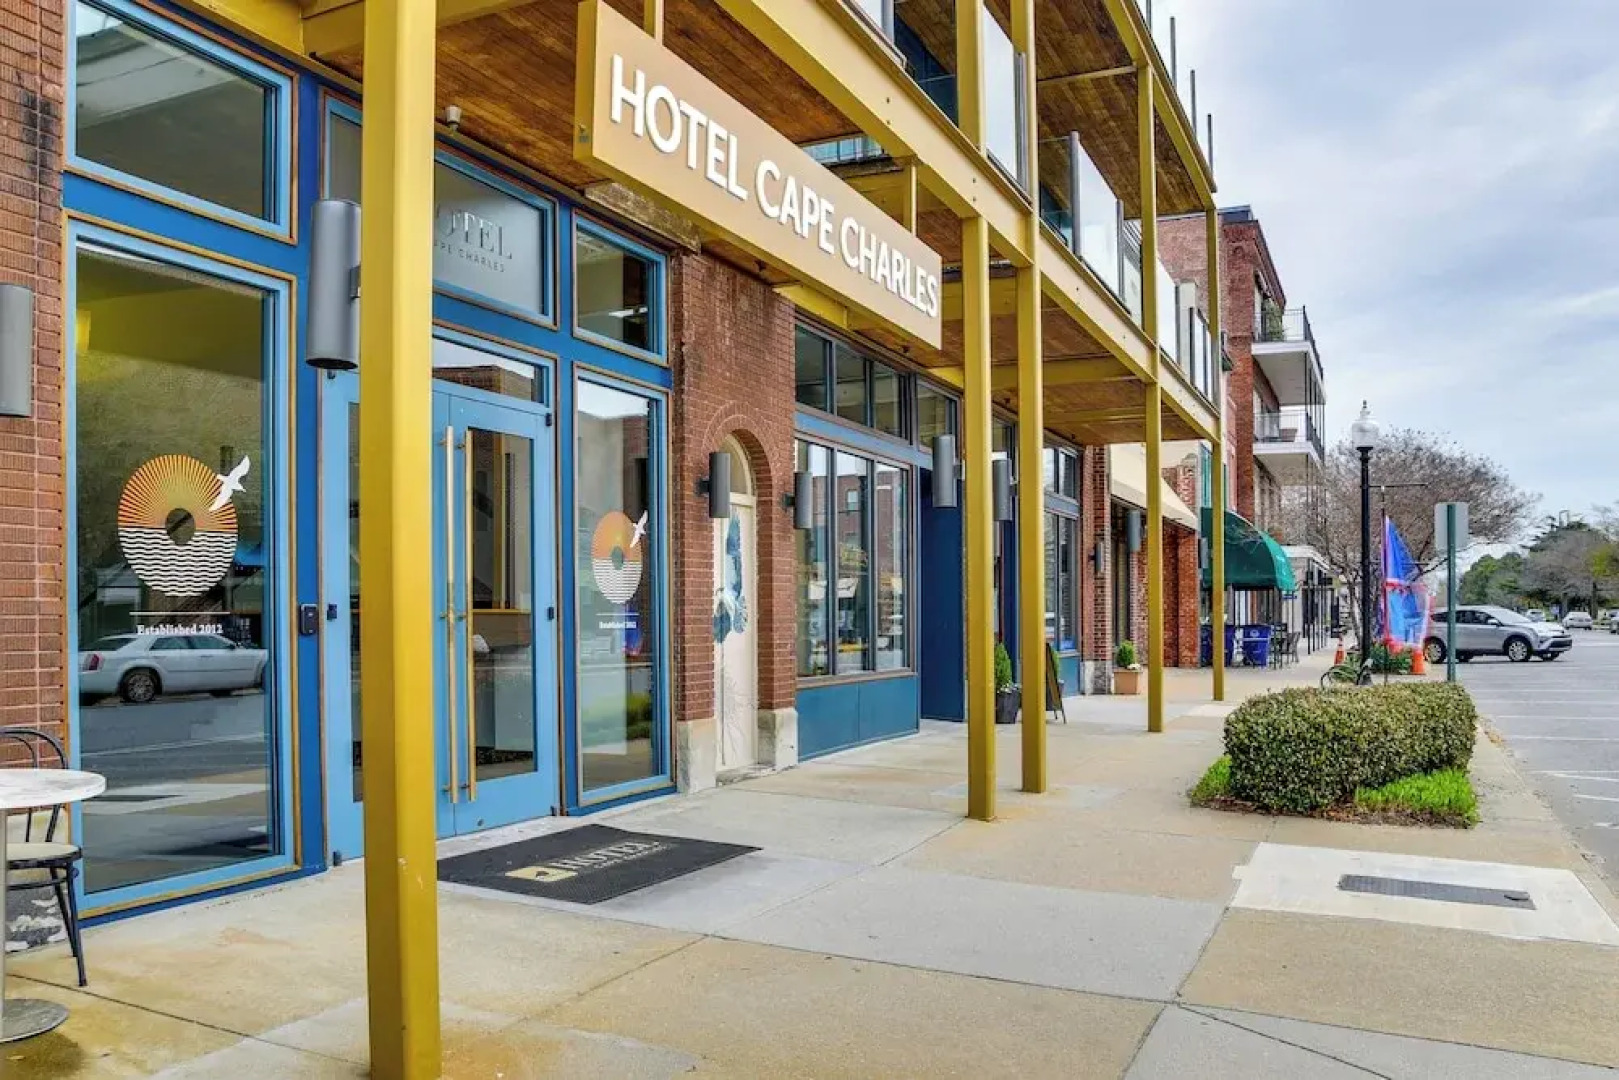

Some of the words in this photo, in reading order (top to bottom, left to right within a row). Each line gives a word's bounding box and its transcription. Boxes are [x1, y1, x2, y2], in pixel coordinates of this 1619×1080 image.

[610, 53, 748, 201] HOTEL
[755, 159, 835, 254] CAPE
[839, 216, 938, 318] CHARLES
[435, 203, 513, 260] OTEL
[136, 623, 197, 635] Established
[198, 623, 223, 634] 2012
